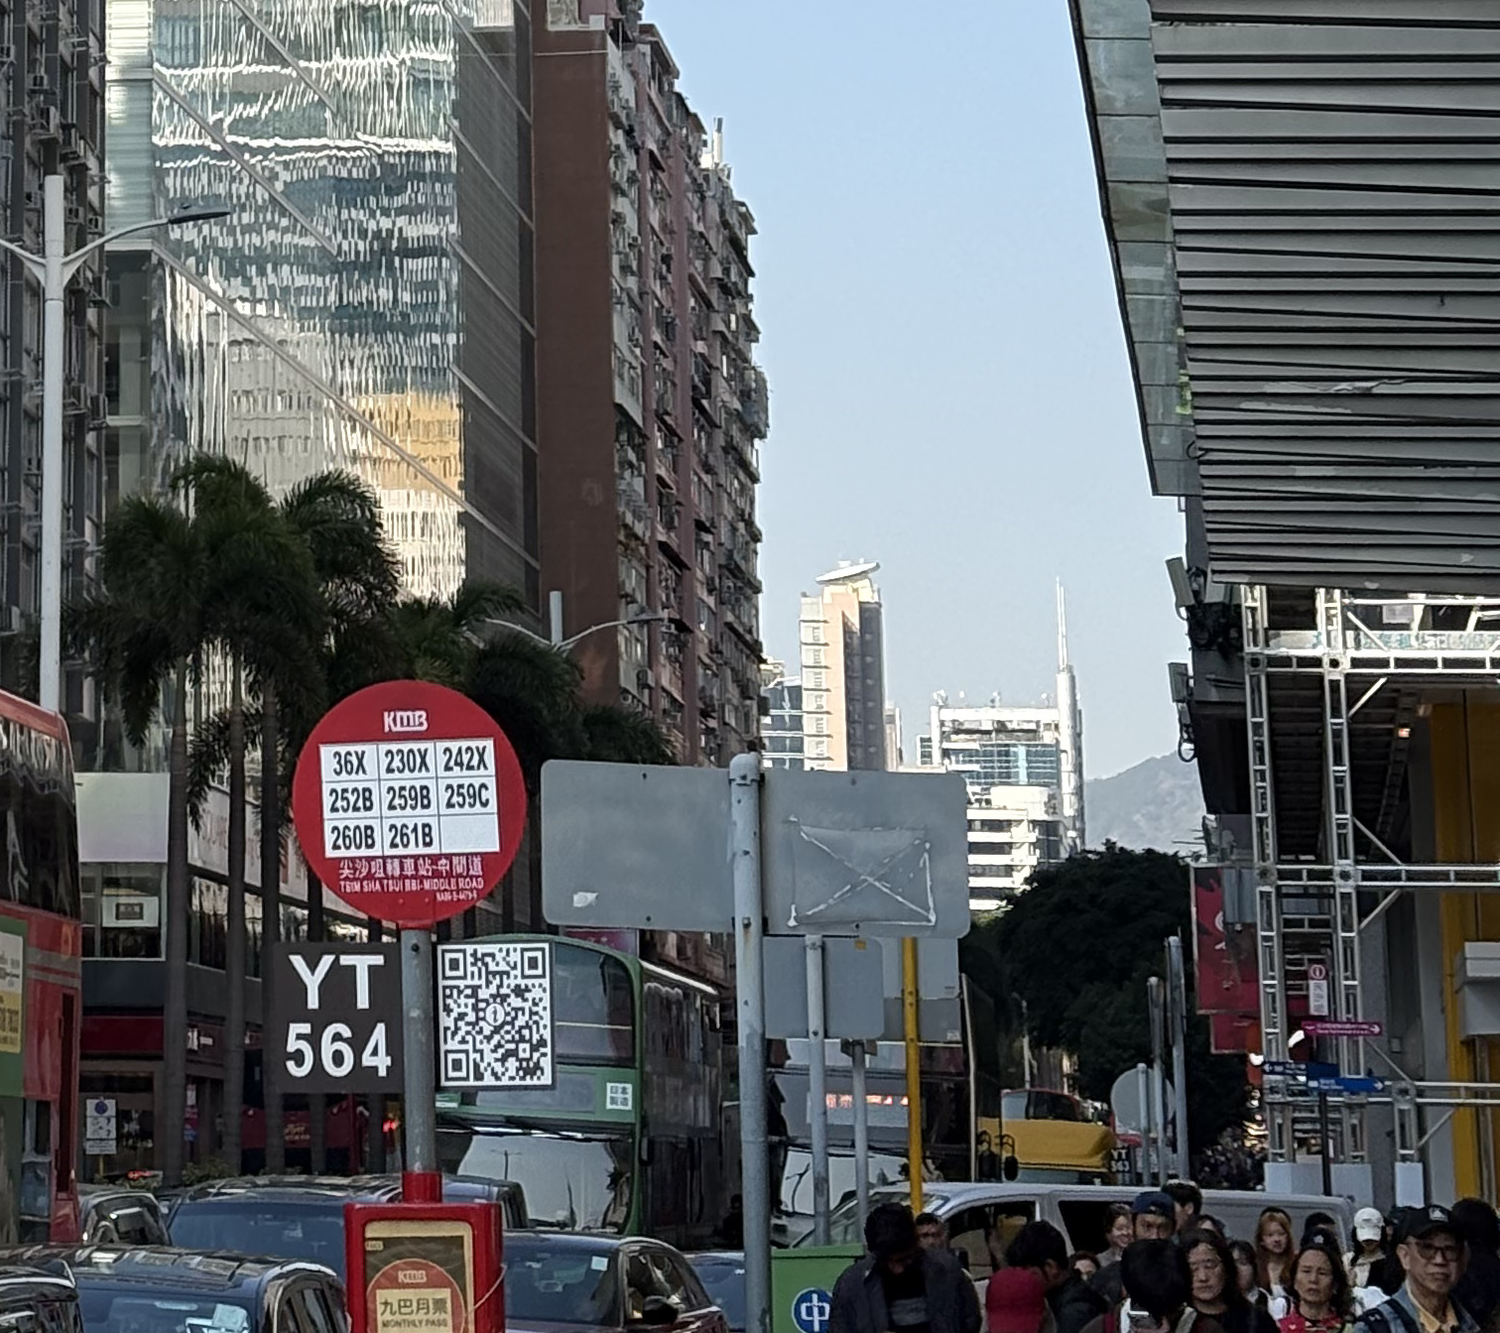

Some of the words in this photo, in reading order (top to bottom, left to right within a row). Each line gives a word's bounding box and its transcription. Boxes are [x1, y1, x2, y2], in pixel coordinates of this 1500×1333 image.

[384, 710, 428, 732] KMB
[333, 750, 367, 776] 36X
[385, 748, 431, 774] 230X
[443, 745, 488, 772] 242X
[329, 787, 374, 813] 252B
[386, 785, 431, 811] 259B
[444, 783, 490, 809] 259C
[331, 824, 376, 851] 260B
[388, 822, 433, 849] 261B
[363, 879, 381, 892] SHA
[383, 879, 403, 892] TSUI
[458, 877, 484, 890] ROAD
[288, 954, 385, 1010] YT
[285, 1022, 392, 1078] 564
[380, 1297, 448, 1317] 九巴月票
[382, 1319, 423, 1329] MONTHLY
[425, 1318, 448, 1328] PASS
